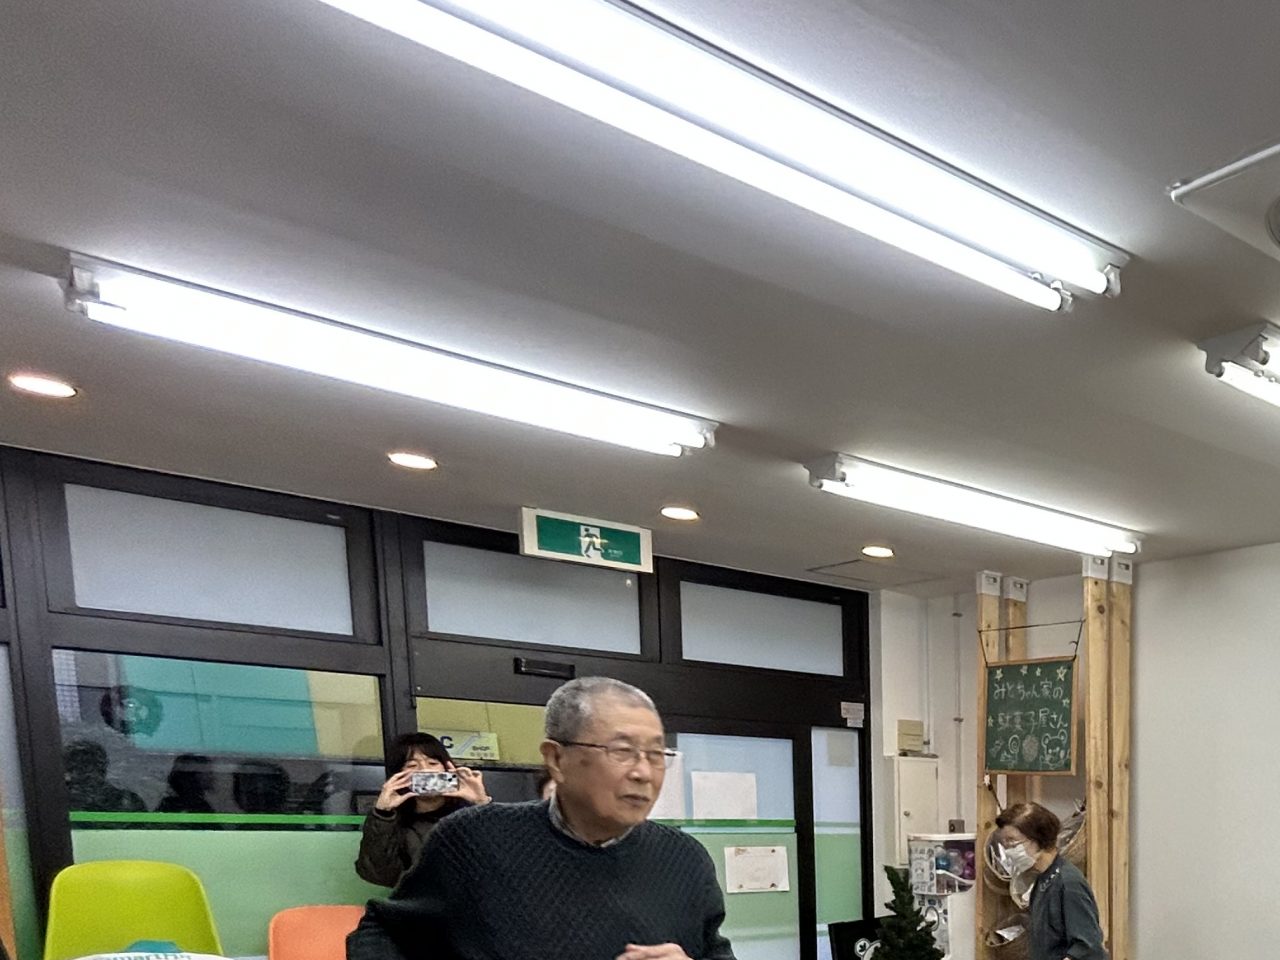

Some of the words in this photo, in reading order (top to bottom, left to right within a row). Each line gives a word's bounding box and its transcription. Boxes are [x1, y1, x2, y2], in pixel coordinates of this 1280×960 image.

[998, 708, 1068, 733] 駄菓子屋さん
